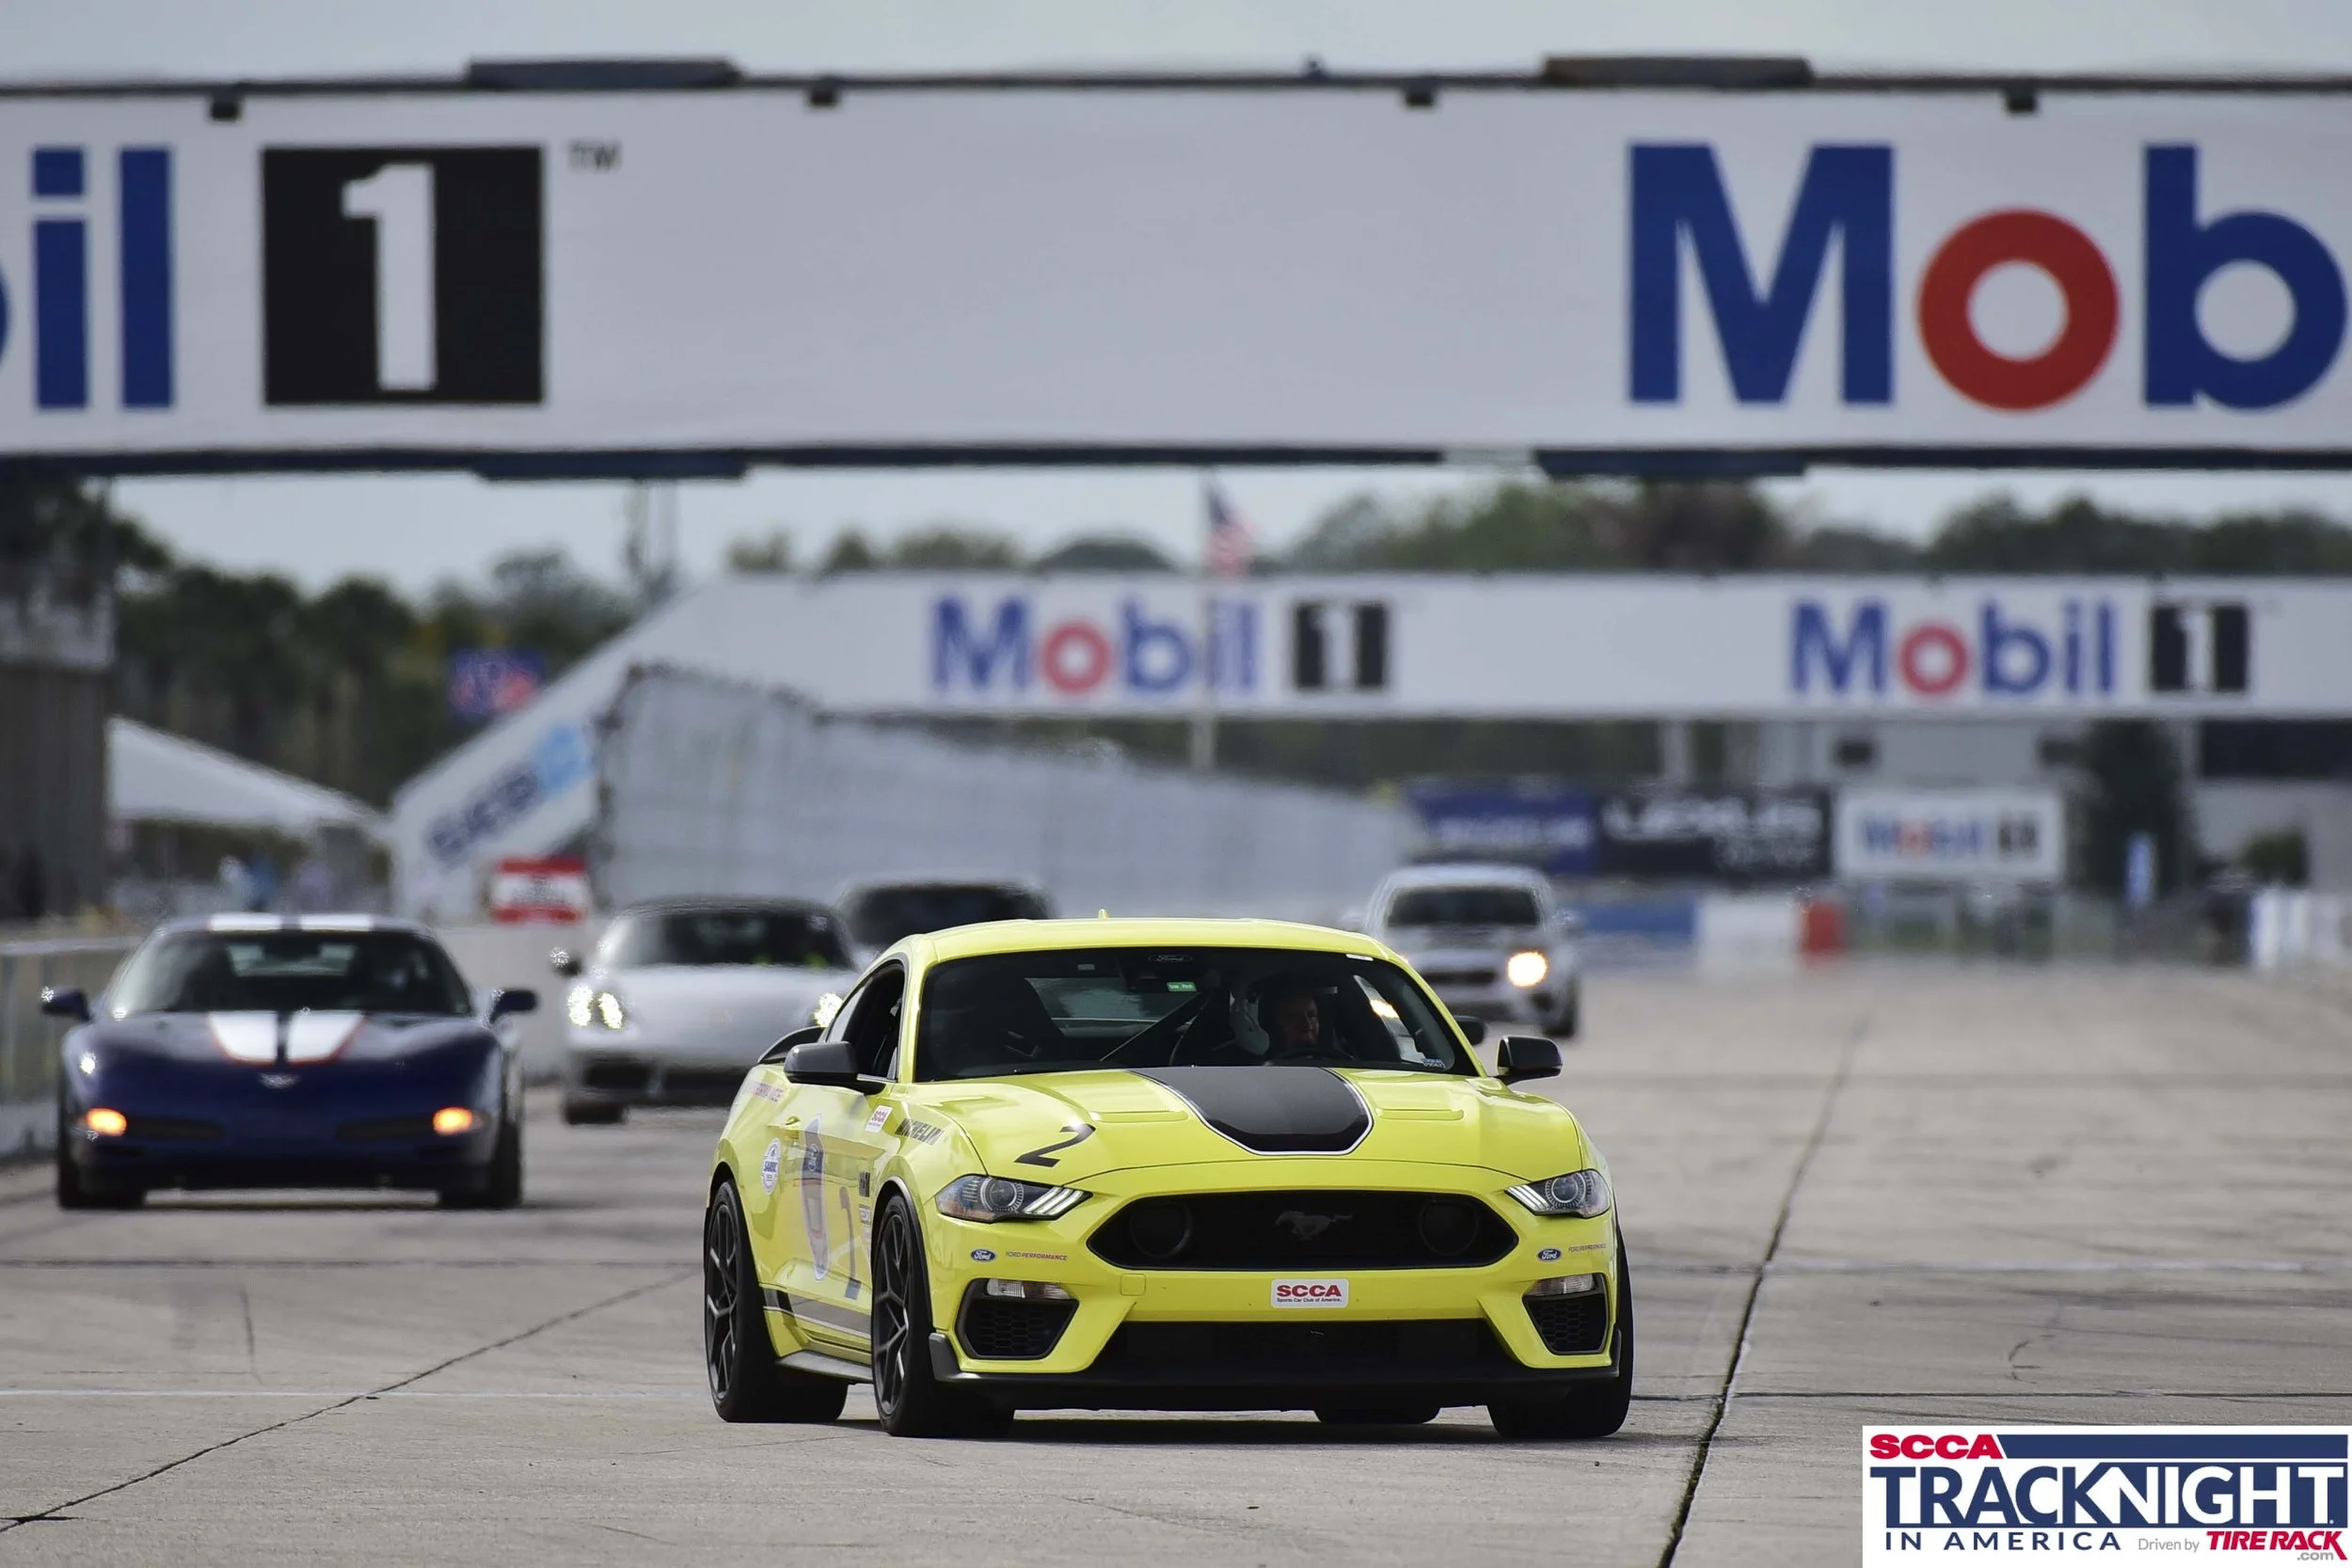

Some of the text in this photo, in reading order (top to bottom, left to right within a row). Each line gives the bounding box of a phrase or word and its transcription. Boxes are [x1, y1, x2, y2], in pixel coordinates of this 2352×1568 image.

[1791, 599, 2115, 695] Mobil
[1014, 1123, 1096, 1167] 2
[973, 1249, 993, 1261] Ford
[1541, 1248, 1558, 1259] Ford
[1277, 1284, 1342, 1297] SCCA
